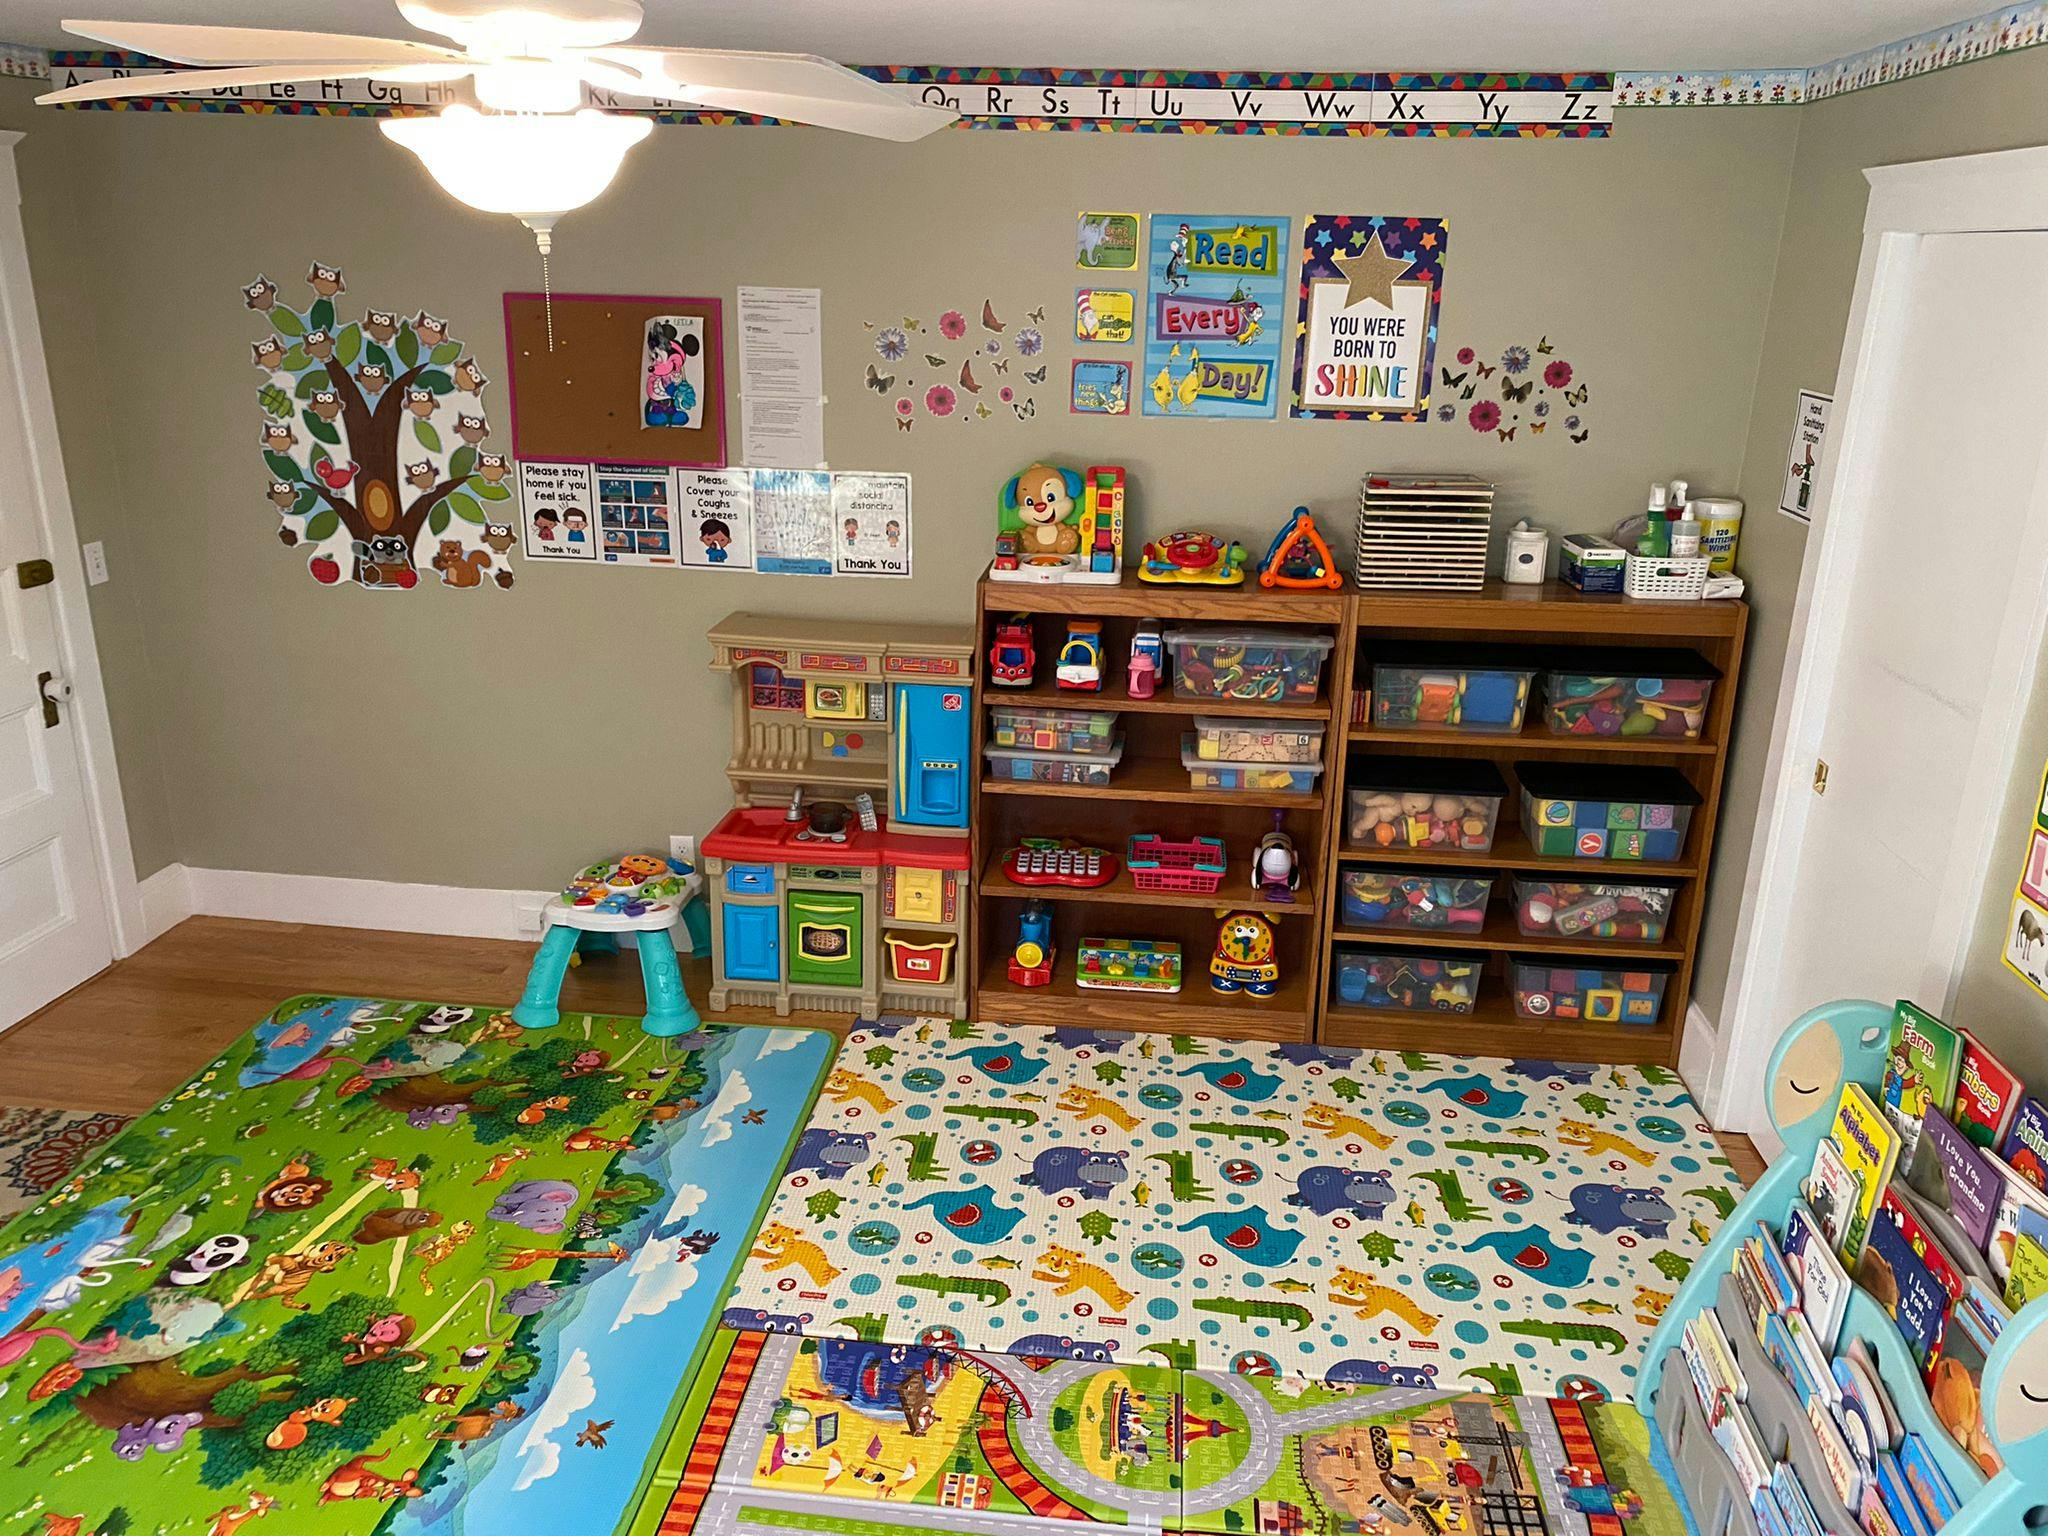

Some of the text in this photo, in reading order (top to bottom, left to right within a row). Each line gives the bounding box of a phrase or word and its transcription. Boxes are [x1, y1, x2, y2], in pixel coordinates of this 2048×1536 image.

[425, 82, 455, 102] Hh
[987, 87, 1012, 113] Rr
[1041, 88, 1069, 114] Ss
[1097, 89, 1120, 115] Tt
[1151, 90, 1183, 116] Uu
[1231, 91, 1263, 117] Vv
[1304, 92, 1355, 118] Ww
[1387, 92, 1425, 120] Xx
[1477, 92, 1509, 131] Yy
[1562, 93, 1598, 121] Zz
[1194, 233, 1269, 271] Read
[1166, 306, 1239, 336] Every
[1330, 317, 1405, 337] YOU WERE
[1333, 339, 1397, 359] BORN TO
[1202, 362, 1264, 400] Day!
[1314, 364, 1408, 399] SHINE
[526, 465, 584, 477] Please stay
[526, 478, 587, 490] home if you
[697, 475, 728, 485] Please
[535, 491, 581, 502] feel sick.
[686, 486, 739, 498] Cover your
[697, 498, 730, 509] Coughs
[700, 510, 738, 520] Sneezes
[543, 546, 581, 555] Thank You
[844, 558, 902, 569] Thank You
[1903, 1023, 1935, 1058] Farm
[1961, 1064, 2000, 1111] mbers
[1840, 1104, 1881, 1167] Alphabet
[1940, 1133, 1945, 1145] I
[1946, 1139, 1964, 1167] Love
[1949, 1165, 1985, 1213] Grandma
[1909, 1273, 1933, 1310] I Love
[1901, 1297, 1926, 1340] Daddy
